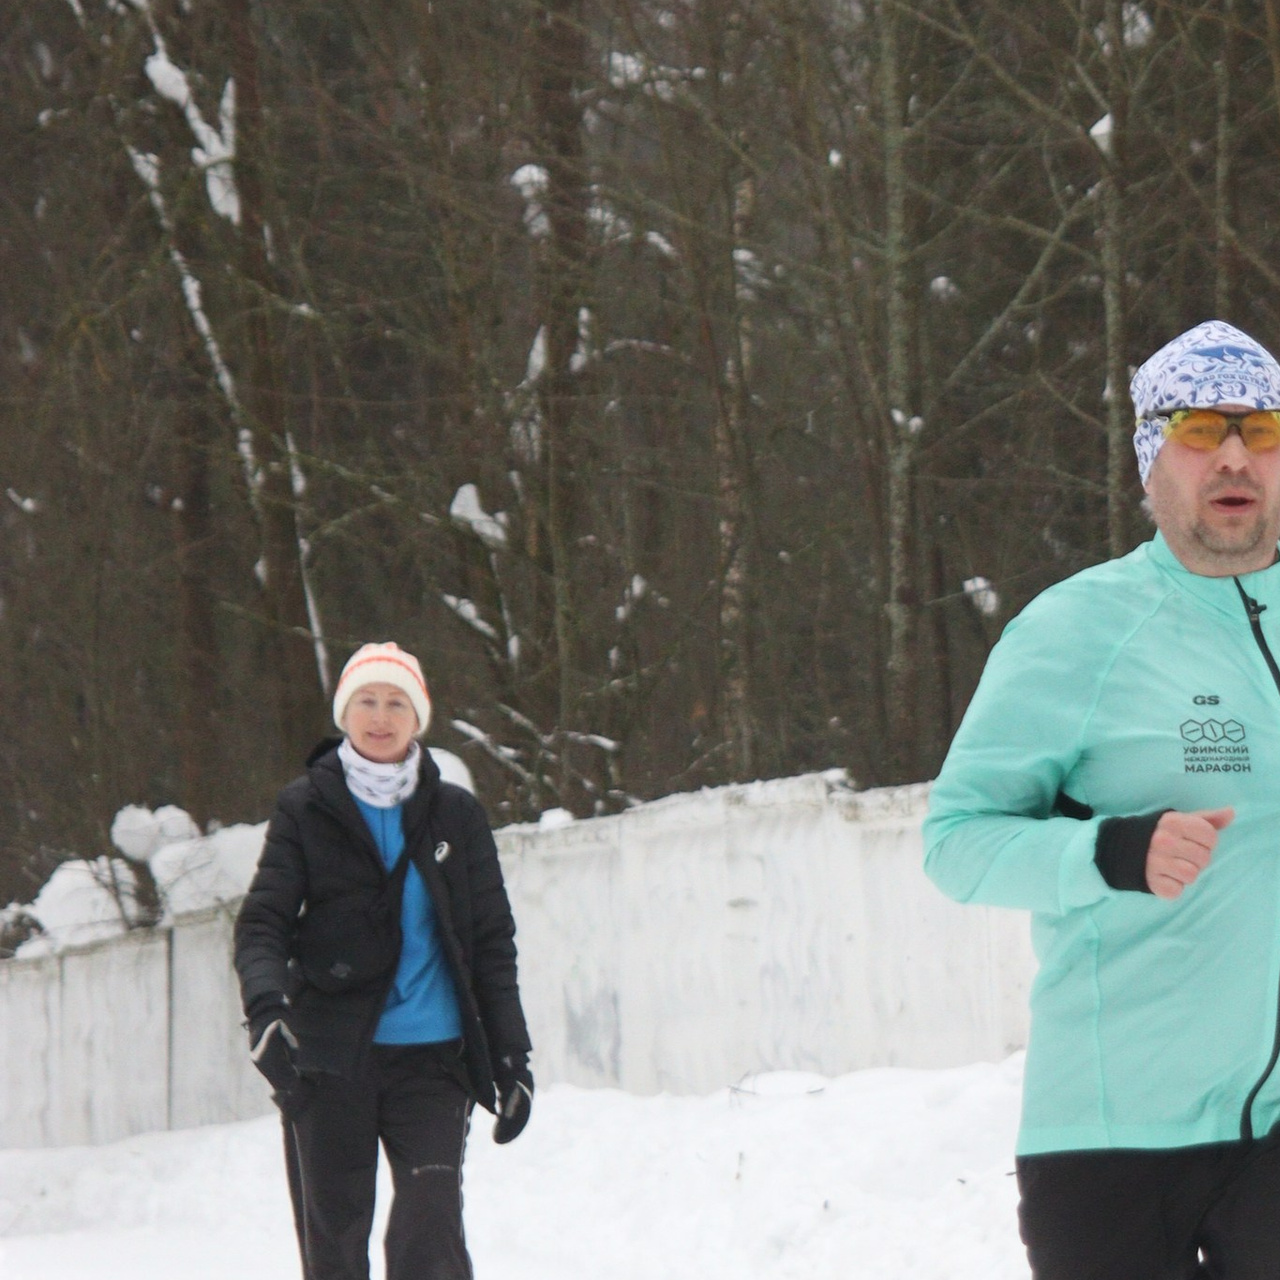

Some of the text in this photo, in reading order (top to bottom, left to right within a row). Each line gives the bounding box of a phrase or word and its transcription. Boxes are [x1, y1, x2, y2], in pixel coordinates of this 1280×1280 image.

[1194, 374, 1215, 384] MAD
[1193, 695, 1220, 705] GS
[1183, 745, 1249, 754] УФИМСКИЙ
[1184, 763, 1252, 773] МАРАФОН
